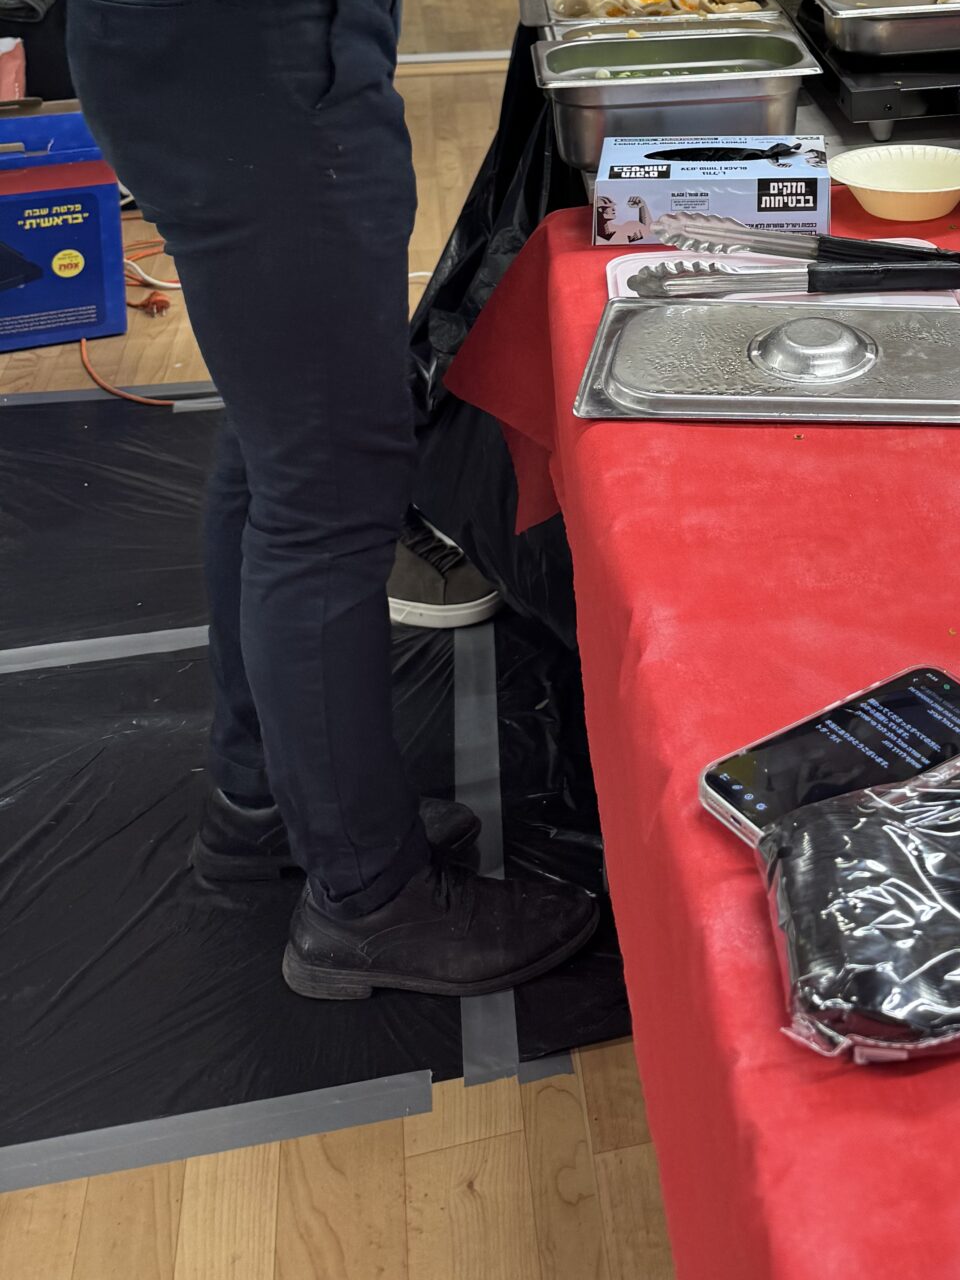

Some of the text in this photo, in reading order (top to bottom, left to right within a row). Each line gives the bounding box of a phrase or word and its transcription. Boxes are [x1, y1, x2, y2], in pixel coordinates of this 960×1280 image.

[770, 182, 806, 195] חזקים
[761, 195, 814, 208] בבטיחות
[24, 204, 82, 217] פלטת שבת
